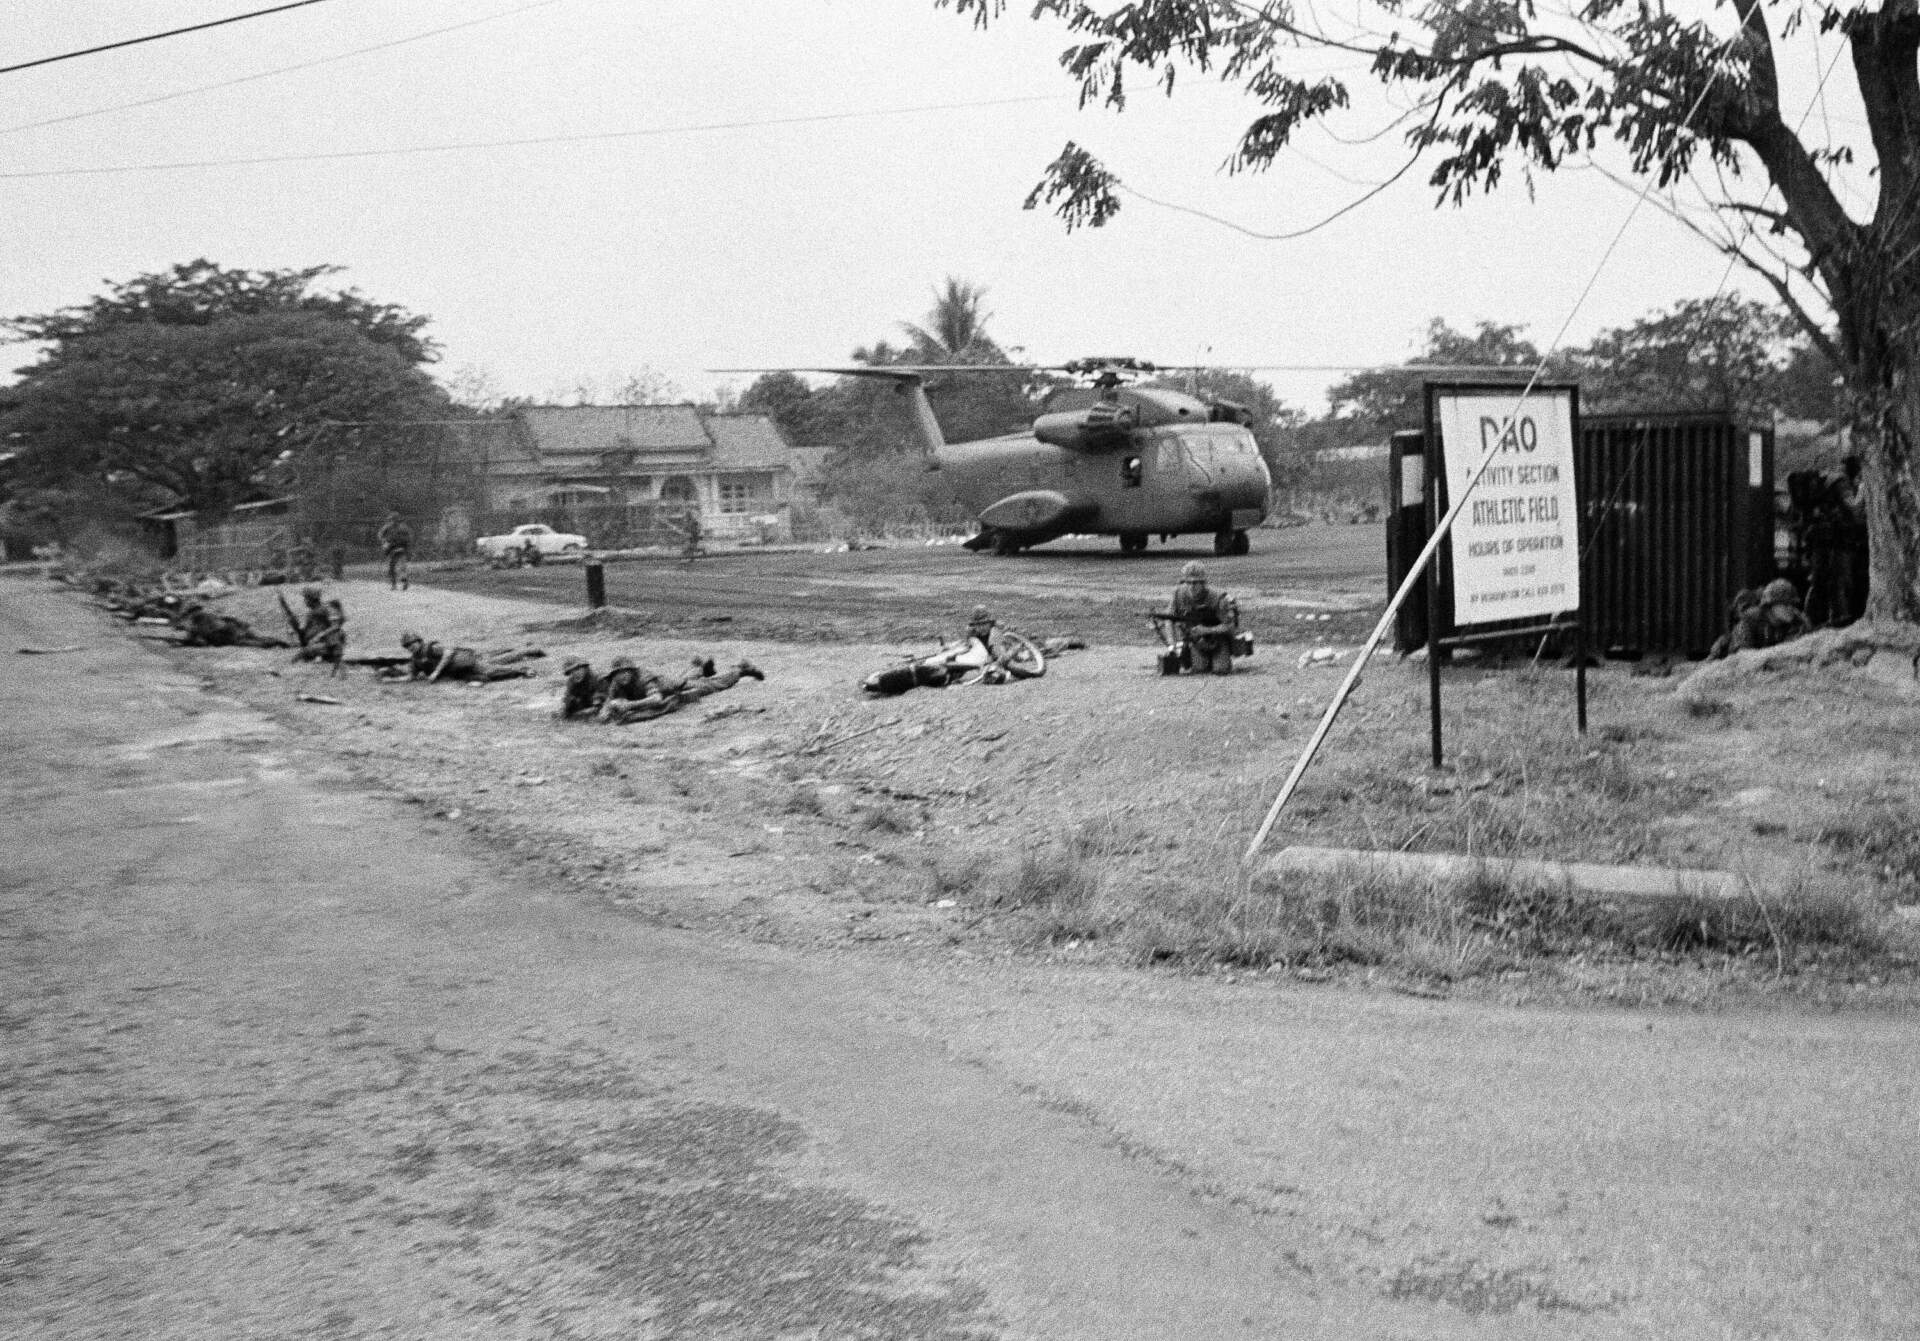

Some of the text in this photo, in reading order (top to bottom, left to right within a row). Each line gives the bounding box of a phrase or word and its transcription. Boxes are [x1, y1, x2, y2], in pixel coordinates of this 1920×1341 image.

[1480, 416, 1537, 453] DAO
[1467, 465, 1559, 486] TIVITY SECTION
[1472, 498, 1525, 525] ATHLETIC
[1529, 496, 1558, 522] FIELD
[1469, 535, 1563, 556] HOURS OF OPERATION
